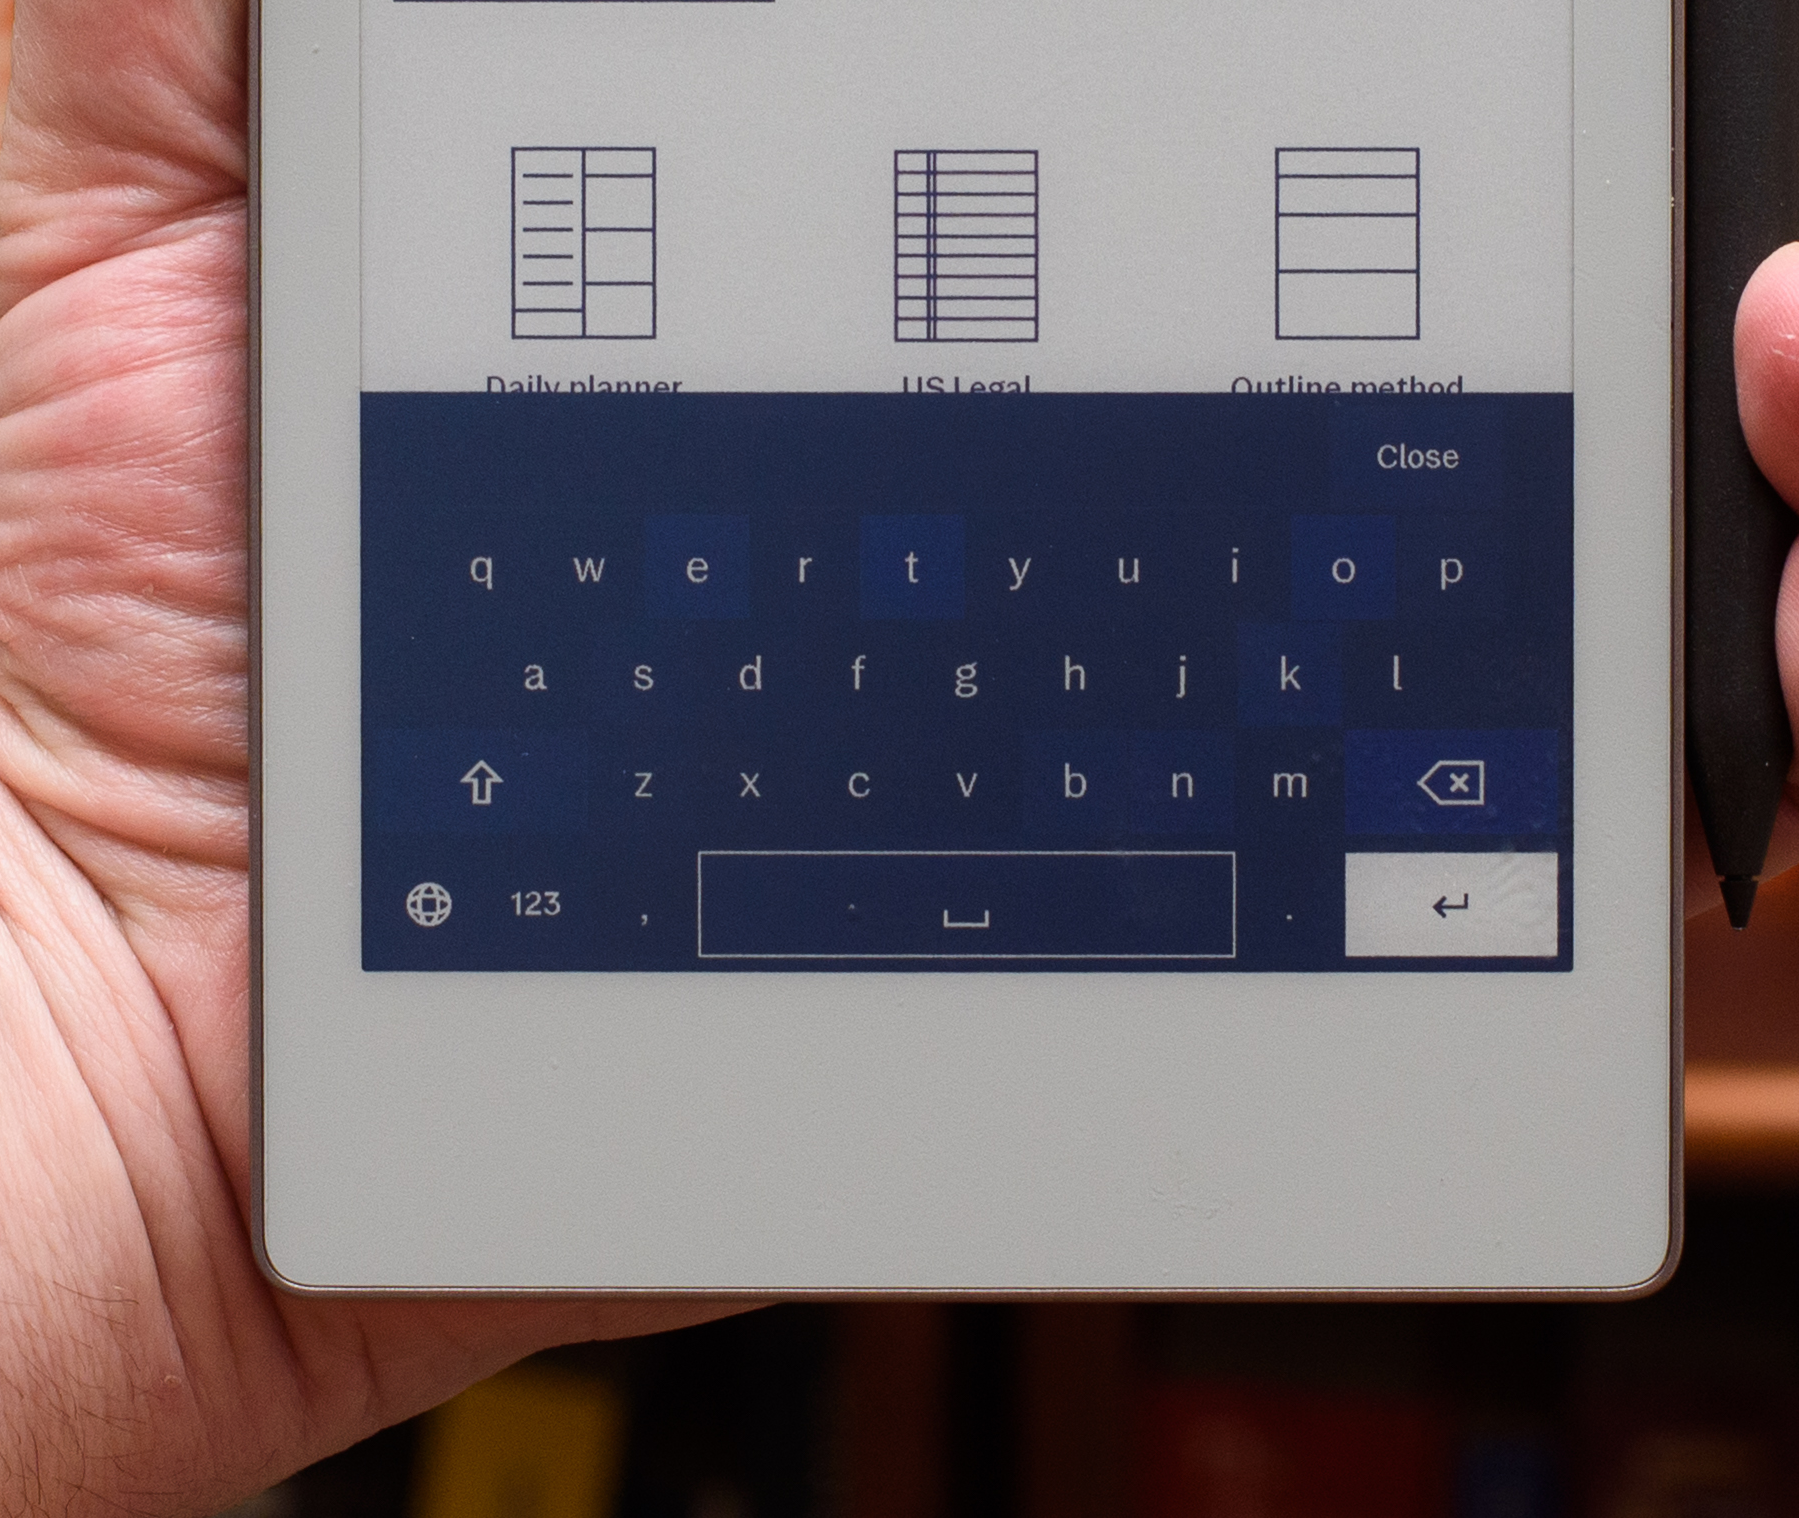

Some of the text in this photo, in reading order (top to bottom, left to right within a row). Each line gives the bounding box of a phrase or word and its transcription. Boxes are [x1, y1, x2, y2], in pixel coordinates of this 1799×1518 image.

[1376, 443, 1461, 471] Close
[470, 547, 1466, 593] q w e r t y u i o p
[524, 654, 1404, 701] a s d f g h j k l
[634, 762, 1310, 800] z x c v b n m
[511, 890, 563, 918] 123
